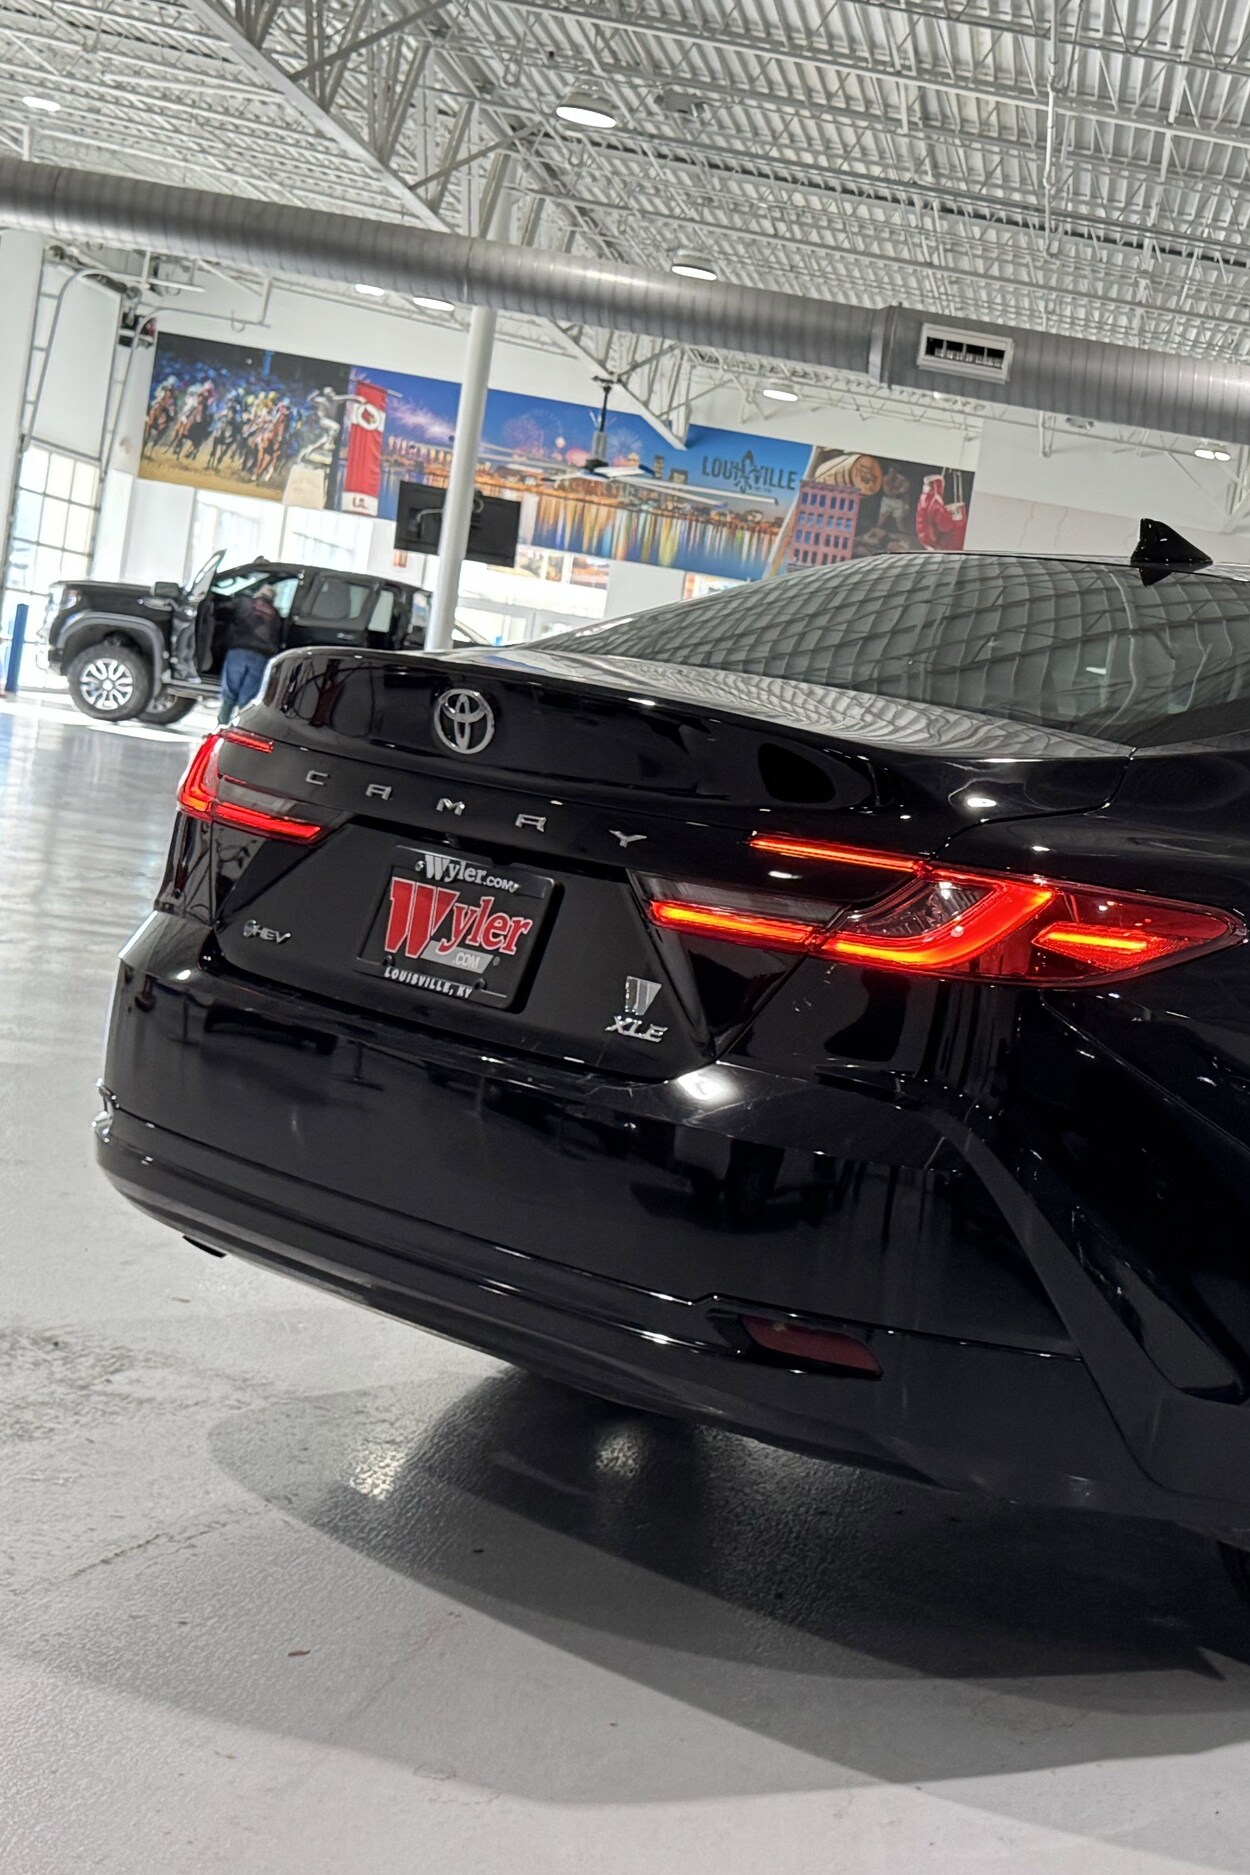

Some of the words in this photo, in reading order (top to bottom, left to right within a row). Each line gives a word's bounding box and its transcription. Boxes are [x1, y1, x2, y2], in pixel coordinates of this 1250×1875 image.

[306, 768, 648, 848] CAMRY
[384, 876, 534, 960] Wyler
[384, 966, 455, 996] LOUISVILLE,
[456, 982, 473, 999] KY
[605, 1015, 669, 1043] XLE
